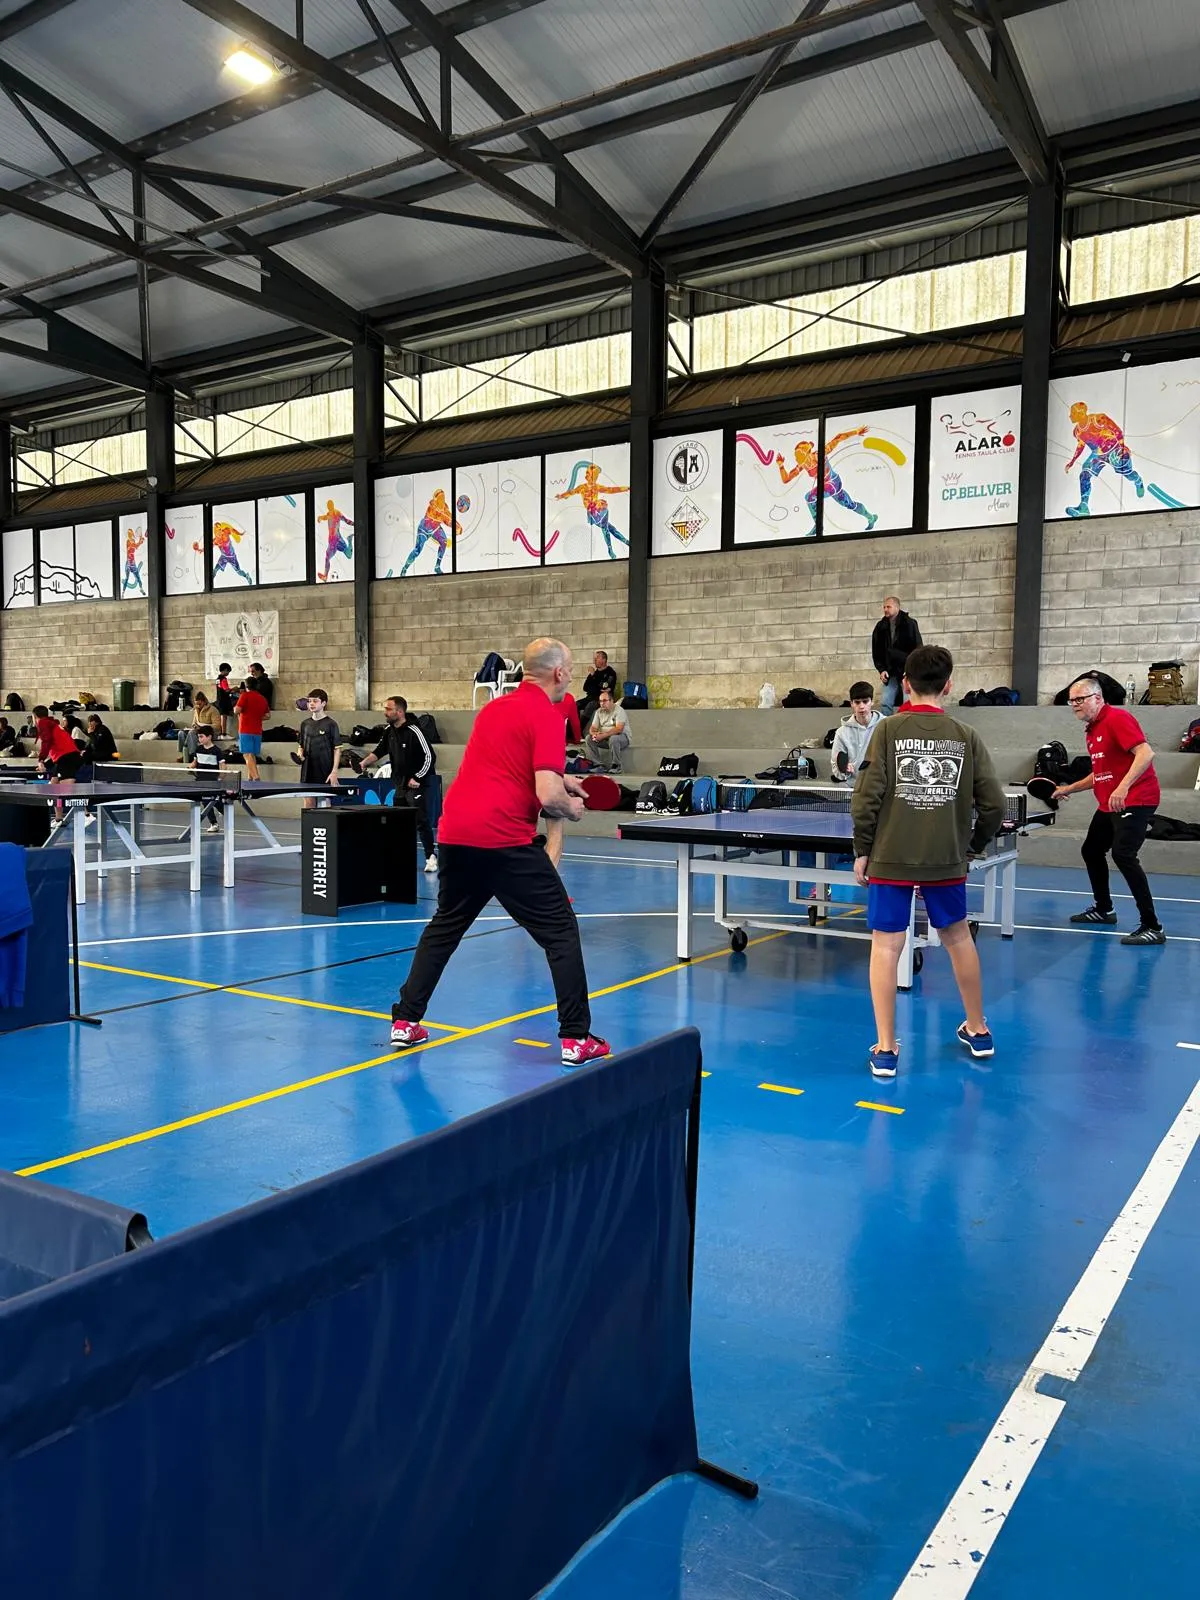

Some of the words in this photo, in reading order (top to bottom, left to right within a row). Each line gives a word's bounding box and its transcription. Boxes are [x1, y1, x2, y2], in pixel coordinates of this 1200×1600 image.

[955, 452, 977, 460] TENNIS
[978, 449, 998, 457] TAULA
[998, 447, 1015, 455] CLUB
[942, 482, 1012, 501] CP.BELLVER
[895, 738, 966, 754] WORLDWIDE
[65, 798, 89, 807] BUTTERFLY
[312, 827, 327, 899] BUTTERFLY
